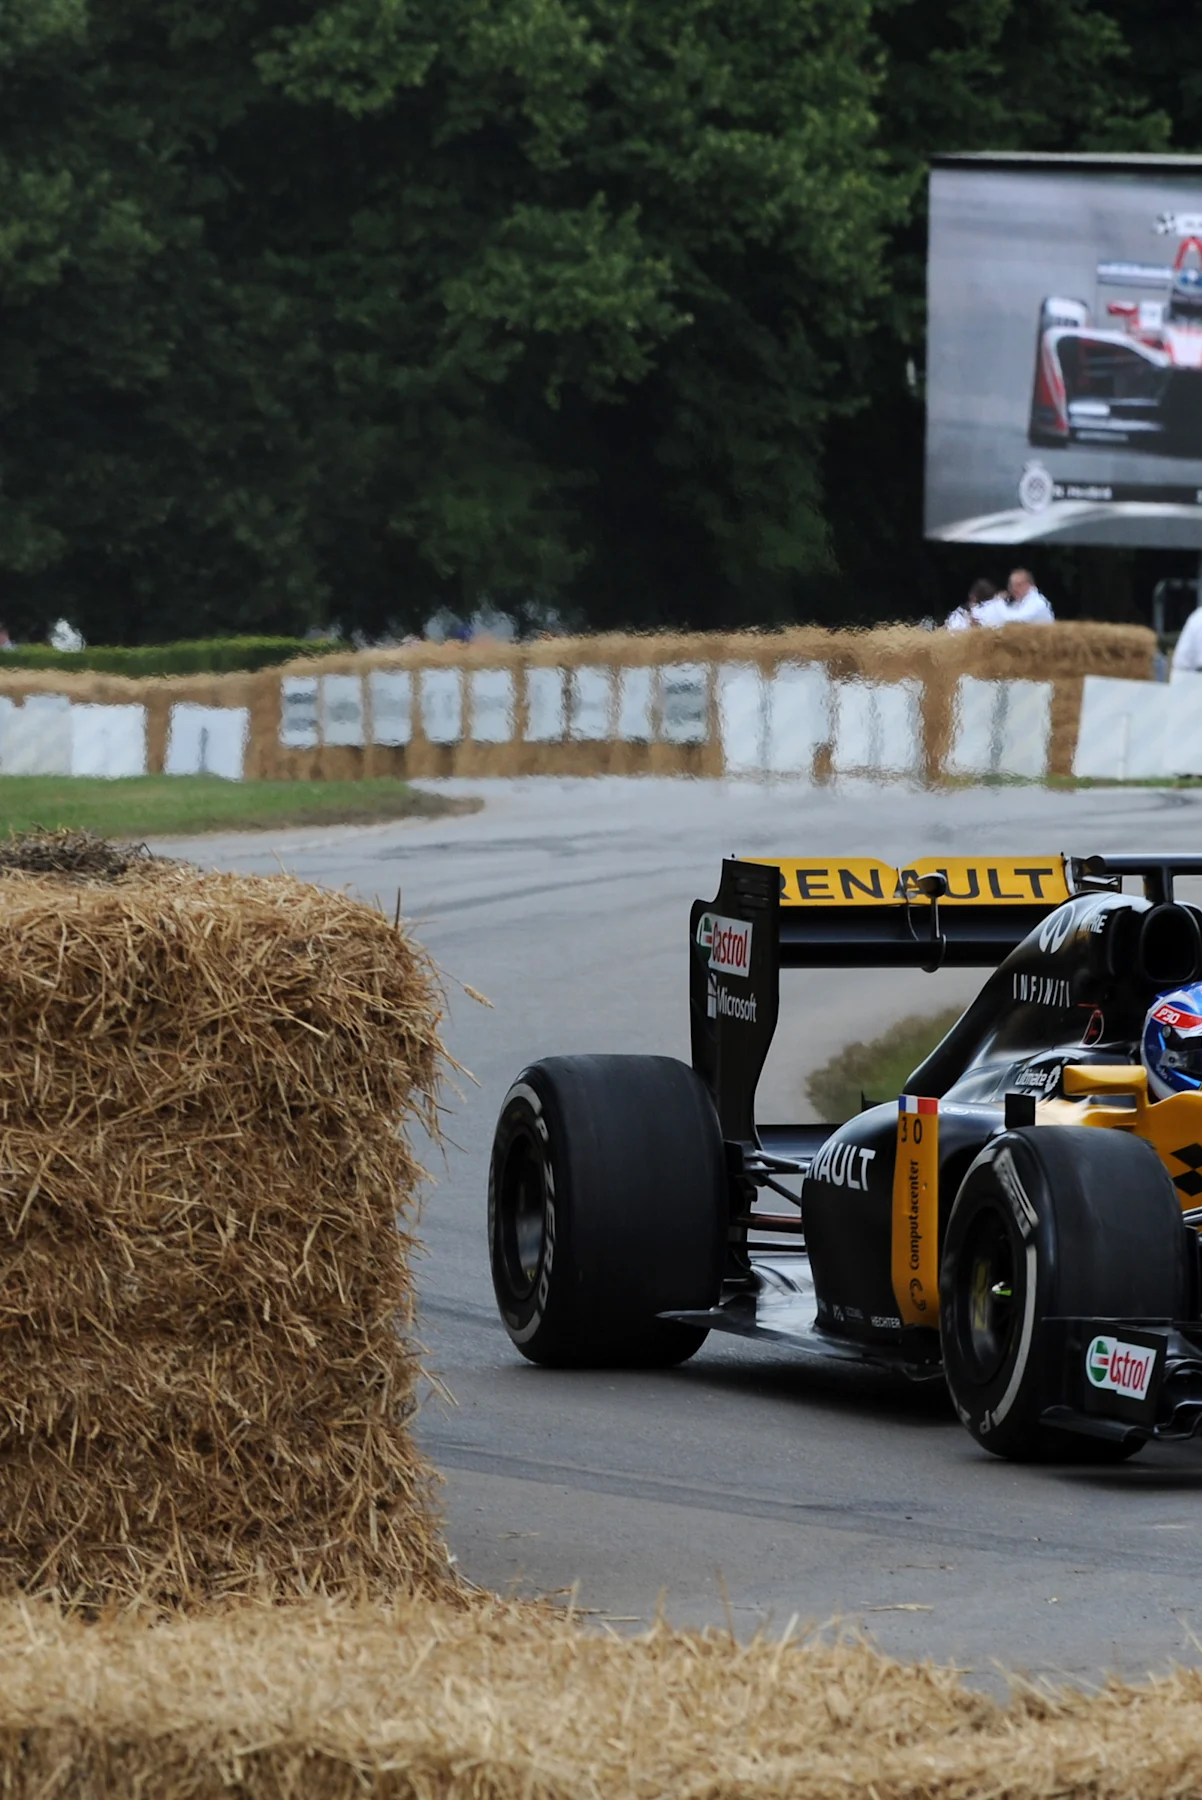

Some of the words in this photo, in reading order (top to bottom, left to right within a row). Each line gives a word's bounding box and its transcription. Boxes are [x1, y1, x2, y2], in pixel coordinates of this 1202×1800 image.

[712, 921, 748, 969] Castrol
[717, 986, 756, 1022] Microsoft
[1013, 973, 1070, 1008] INFINITI
[1156, 1008, 1180, 1025] P30
[1015, 1068, 1048, 1087] ultimate
[806, 1141, 876, 1192] NAULT
